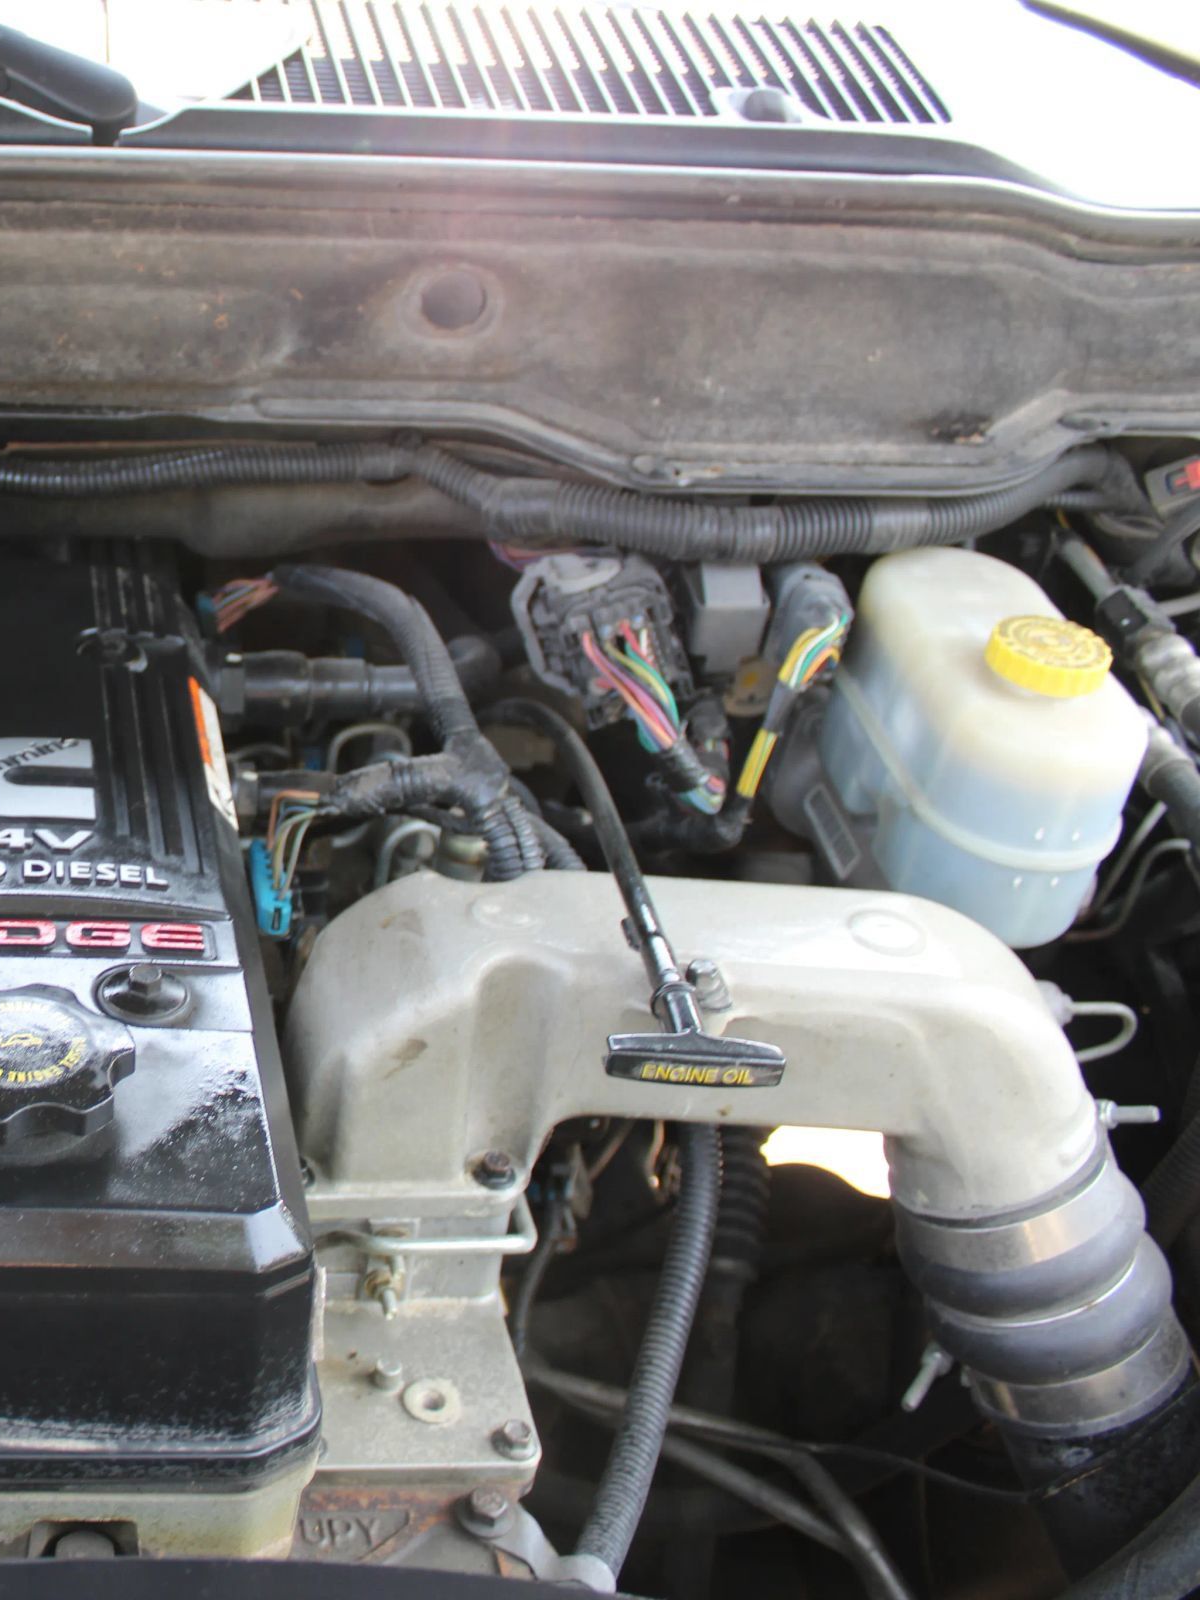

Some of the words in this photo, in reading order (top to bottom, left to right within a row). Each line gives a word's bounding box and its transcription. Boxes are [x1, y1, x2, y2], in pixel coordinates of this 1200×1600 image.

[23, 860, 170, 889] DIESEL
[641, 1062, 719, 1084] ENGINE
[722, 1065, 754, 1085] OIL
